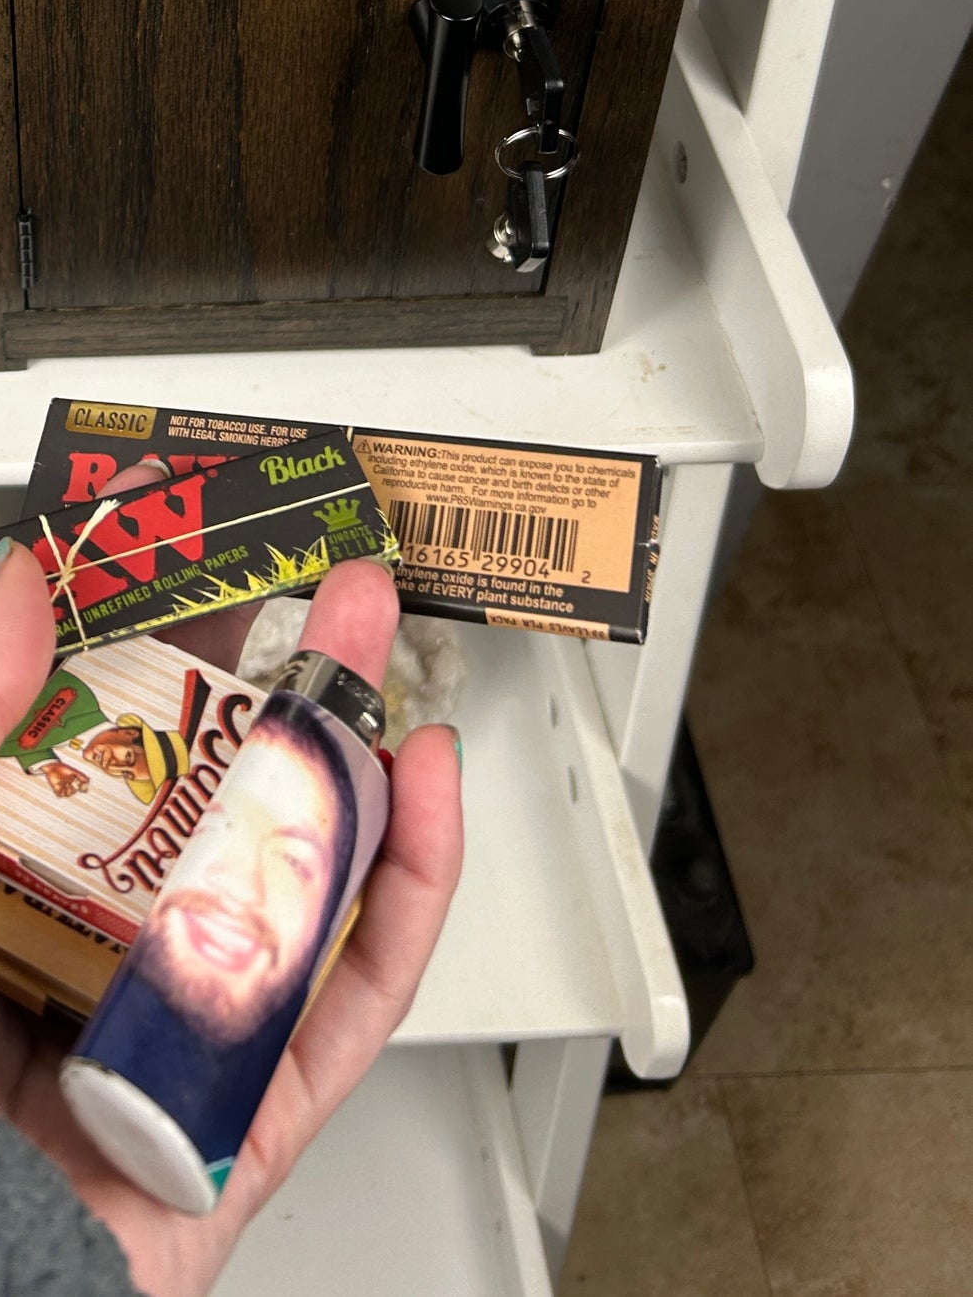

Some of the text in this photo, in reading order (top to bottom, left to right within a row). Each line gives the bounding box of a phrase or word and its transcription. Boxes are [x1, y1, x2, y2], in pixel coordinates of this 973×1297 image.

[74, 407, 147, 433] CLASSIC
[168, 426, 189, 438] WITH
[190, 429, 217, 441] LEGAL
[218, 431, 259, 446] SMOKING
[169, 415, 188, 427] NOT
[188, 417, 206, 429] FOR
[207, 419, 247, 433] TOBACCO
[270, 425, 288, 438] FOR
[289, 427, 308, 439] USE
[259, 445, 347, 486] Black
[368, 453, 408, 468] including
[409, 458, 448, 471] ethylene
[480, 466, 507, 477] which
[509, 468, 517, 478] is
[519, 469, 550, 481] known
[553, 472, 563, 482] to
[564, 473, 580, 484] the
[582, 476, 606, 487] state
[608, 478, 619, 488] of
[442, 450, 459, 461] This
[461, 453, 497, 464] product
[499, 456, 517, 466] can
[518, 459, 553, 470] expose
[555, 462, 574, 473] you
[575, 463, 585, 474] to
[587, 465, 636, 479] chemicals
[372, 464, 611, 499] California to cause cancer and birth defects or other
[382, 477, 597, 510] reproductive harm. For more information go to
[425, 492, 547, 515] www.P65Warnings.ca.gov
[405, 545, 592, 584] 16165 29904 2
[83, 585, 152, 623] UNREFINED
[153, 562, 202, 593] ROLLING
[204, 545, 250, 572] PAPERS
[417, 580, 431, 593] of
[432, 582, 475, 600] EVERY
[476, 588, 509, 605] plant
[510, 594, 574, 613] substance
[441, 571, 475, 585] oxide
[477, 575, 488, 588] is
[490, 575, 526, 592] found
[529, 581, 541, 595] in
[543, 584, 564, 598] the
[490, 614, 518, 627] PACK
[28, 696, 67, 739] CLASSIC
